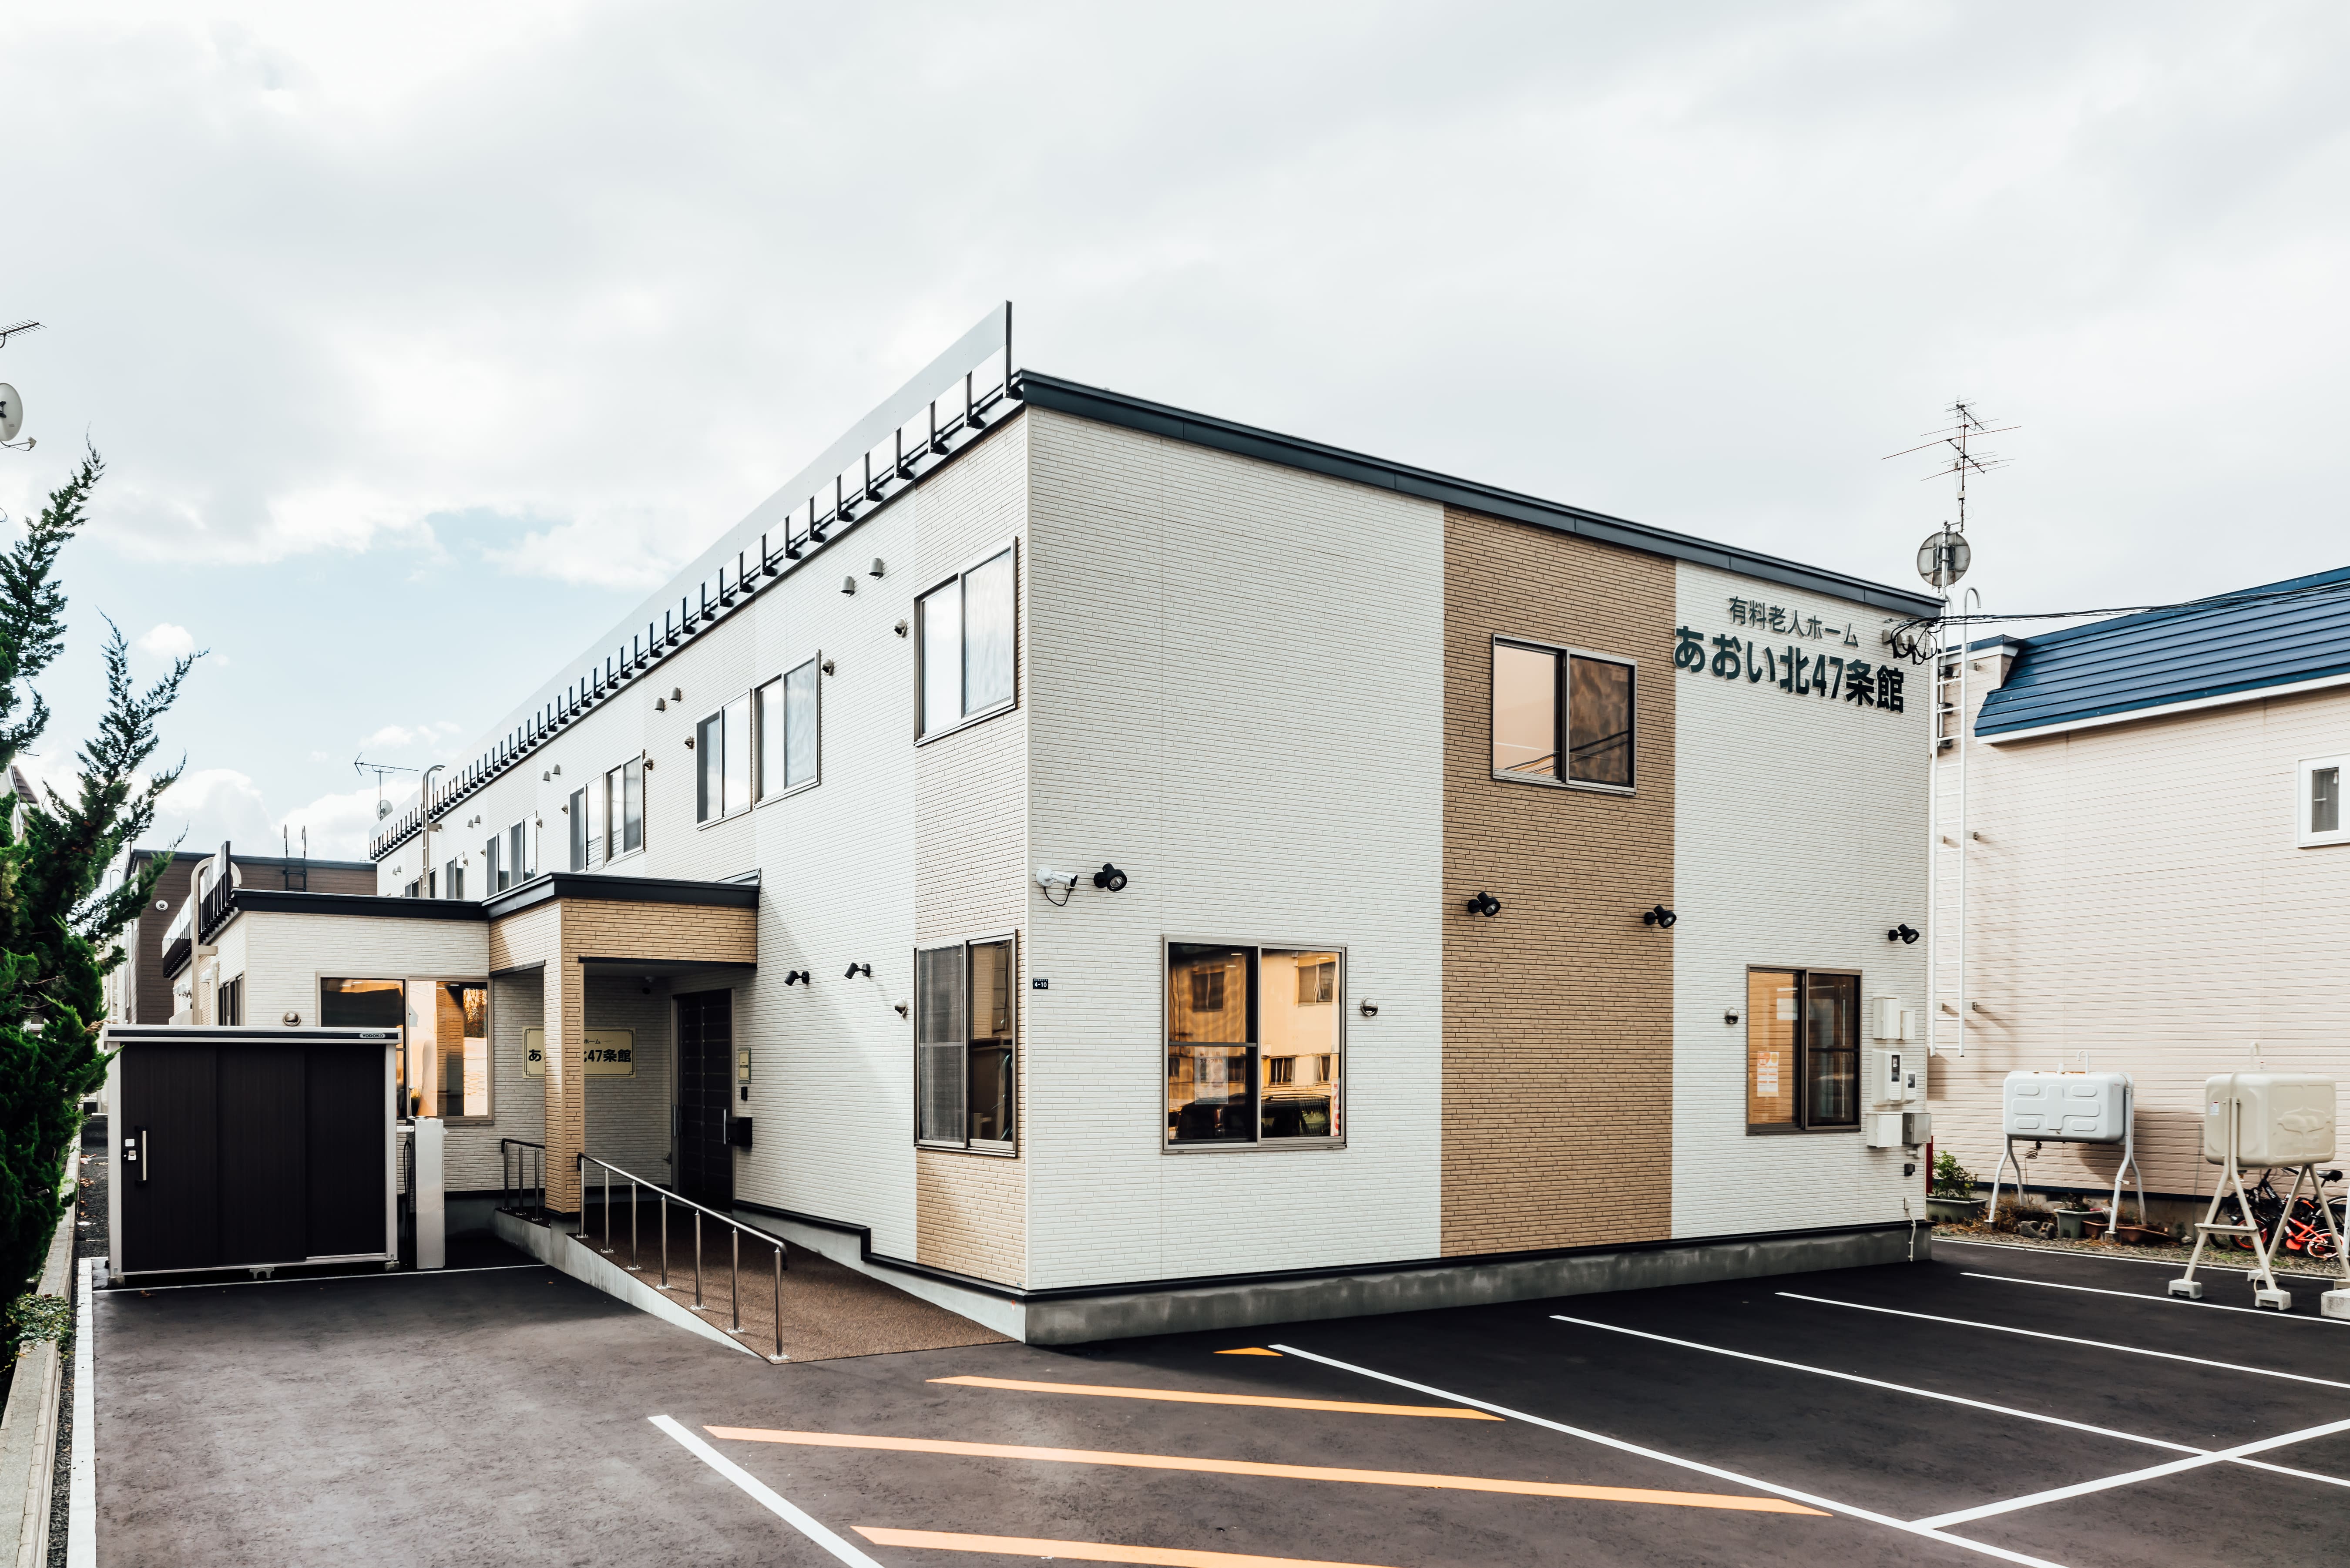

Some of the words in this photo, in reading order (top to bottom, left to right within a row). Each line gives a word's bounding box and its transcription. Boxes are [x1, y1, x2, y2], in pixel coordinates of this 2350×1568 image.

[1727, 596, 1859, 648] 有料老人ホーム
[1674, 625, 1904, 713] あおい北47条館
